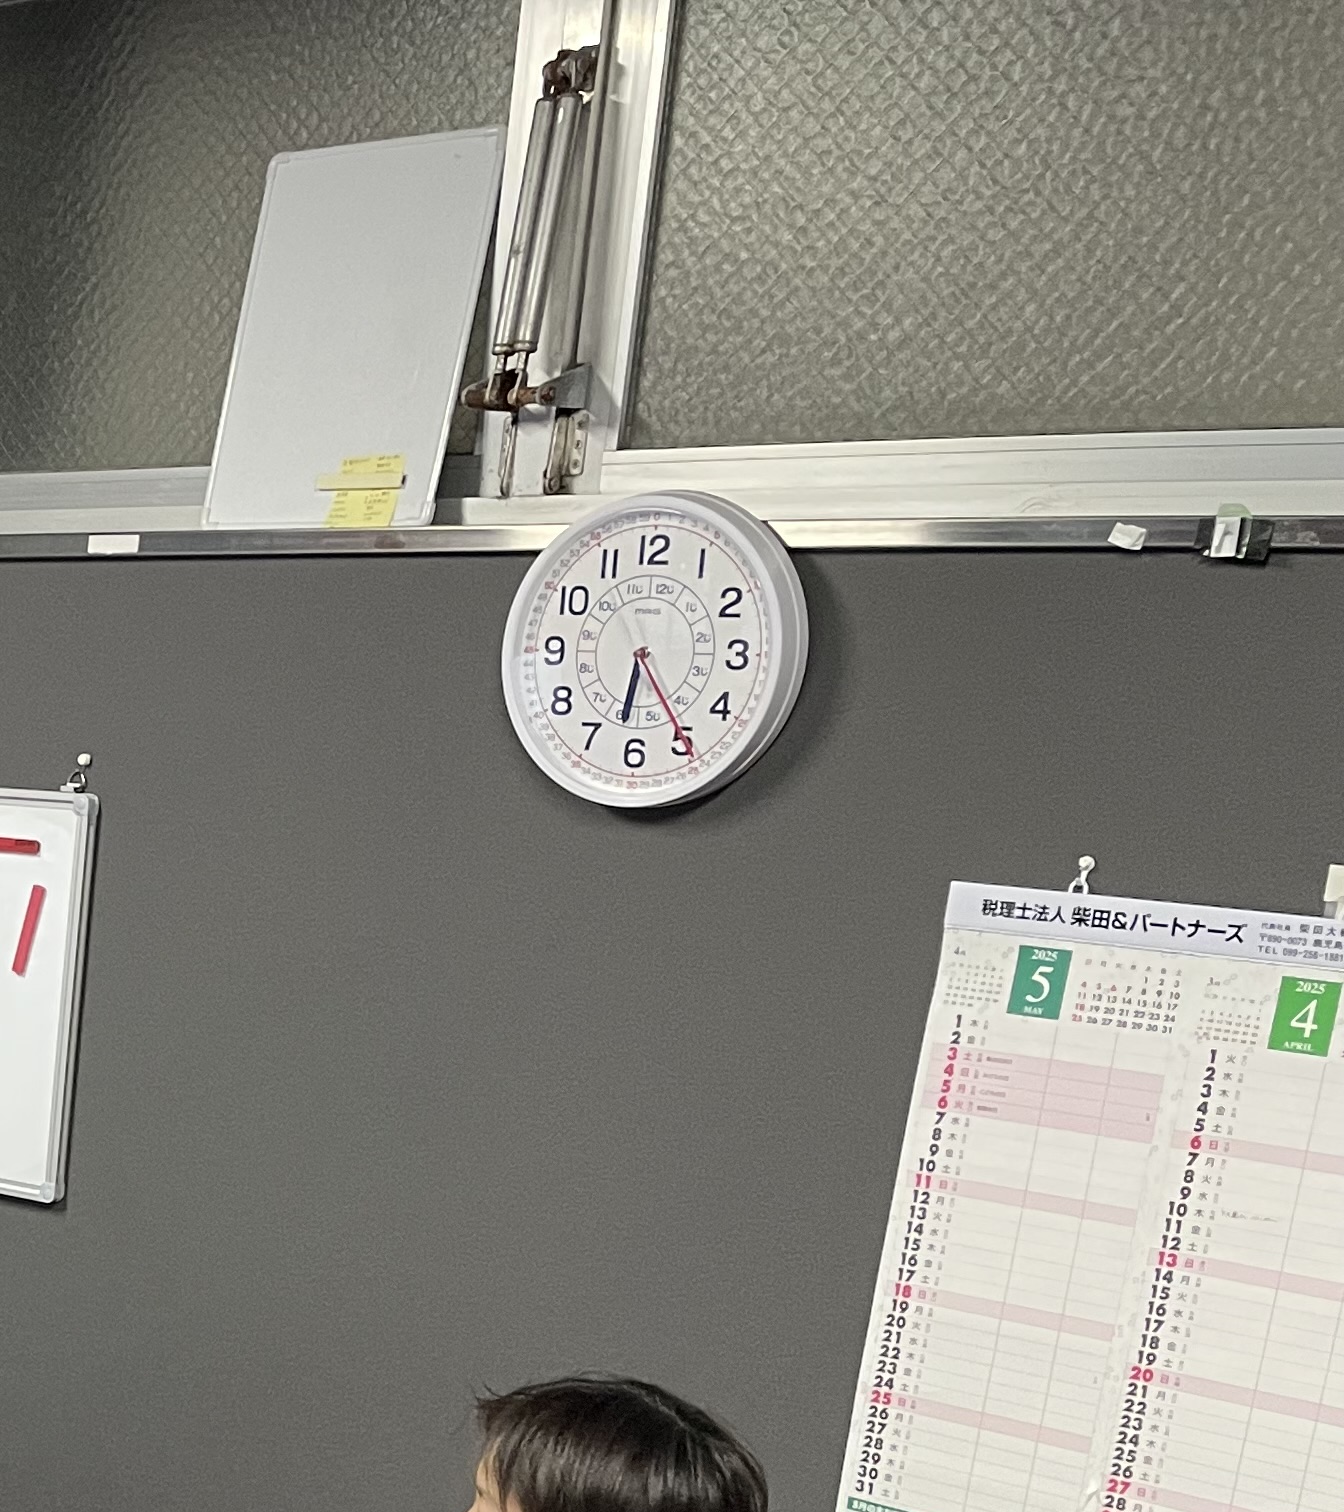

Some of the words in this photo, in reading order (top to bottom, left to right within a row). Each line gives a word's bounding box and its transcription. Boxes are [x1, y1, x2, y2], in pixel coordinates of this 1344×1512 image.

[638, 534, 671, 566] 12
[600, 548, 619, 579] 11
[697, 548, 706, 579] 1
[559, 585, 589, 616] 10
[718, 586, 743, 618] 2
[544, 635, 565, 666] 9
[725, 639, 749, 671] 3
[551, 685, 573, 716] 8
[709, 691, 733, 722] 4
[581, 721, 603, 751] 7
[672, 726, 693, 756] 5
[623, 738, 646, 769] 6
[981, 898, 1066, 924] 税理士法人
[1070, 905, 1247, 943] 柴田&パートナーズ
[1030, 949, 1059, 962] 2025
[1025, 966, 1054, 1003] 5
[1295, 981, 1327, 994] 2025
[1023, 1006, 1044, 1015] MAY
[1290, 999, 1318, 1038] 4
[955, 1013, 963, 1029] 1
[949, 1030, 962, 1045] 2
[1283, 1041, 1313, 1050] APRIL
[946, 1046, 958, 1061] 3
[1210, 1048, 1218, 1064] 1
[943, 1062, 955, 1078] 4
[1202, 1066, 1216, 1082] 2
[940, 1079, 952, 1094] 5
[1199, 1083, 1212, 1099] 3
[937, 1095, 949, 1110] 6
[1196, 1100, 1209, 1116] 4
[934, 1111, 947, 1125] 7
[1193, 1117, 1206, 1133] 5
[931, 1127, 943, 1142] 8
[1189, 1135, 1202, 1150] 6
[929, 1143, 940, 1157] 9
[918, 1157, 936, 1173] 10
[1186, 1151, 1200, 1167] 7
[915, 1173, 932, 1190] 11
[1183, 1169, 1195, 1184] 8
[912, 1189, 931, 1206] 12
[1179, 1185, 1192, 1200] 9
[909, 1204, 927, 1221] 13
[1168, 1200, 1188, 1218] 10
[906, 1220, 924, 1237] 14
[1165, 1217, 1183, 1235] 11
[903, 1236, 922, 1252] 15
[1161, 1234, 1182, 1252] 12
[901, 1251, 918, 1268] 16
[1158, 1250, 1178, 1268] 13
[898, 1267, 917, 1283] 17
[1154, 1267, 1174, 1285] 14
[894, 1282, 913, 1299] 18
[1151, 1284, 1171, 1301] 15
[891, 1298, 909, 1314] 19
[1148, 1300, 1167, 1317] 16
[884, 1313, 907, 1330] 20
[1144, 1317, 1166, 1333] 17
[881, 1328, 902, 1345] 21
[1140, 1333, 1161, 1350] 18
[878, 1343, 901, 1360] 22
[1137, 1349, 1157, 1367] 19
[875, 1359, 898, 1376] 23
[1128, 1365, 1154, 1383] 20
[872, 1374, 895, 1391] 24
[1126, 1381, 1148, 1399] 21
[870, 1389, 893, 1406] 25
[867, 1404, 890, 1421] 26
[1121, 1398, 1147, 1417] 22
[864, 1419, 888, 1435] 27
[1118, 1414, 1144, 1432] 23
[862, 1434, 884, 1451] 28
[1115, 1430, 1140, 1448] 24
[859, 1449, 882, 1466] 29
[1112, 1446, 1137, 1464] 25
[857, 1464, 879, 1480] 30
[1110, 1462, 1134, 1480] 26
[854, 1479, 874, 1496] 31
[1105, 1478, 1132, 1495] 27
[1102, 1494, 1127, 1512] 28
